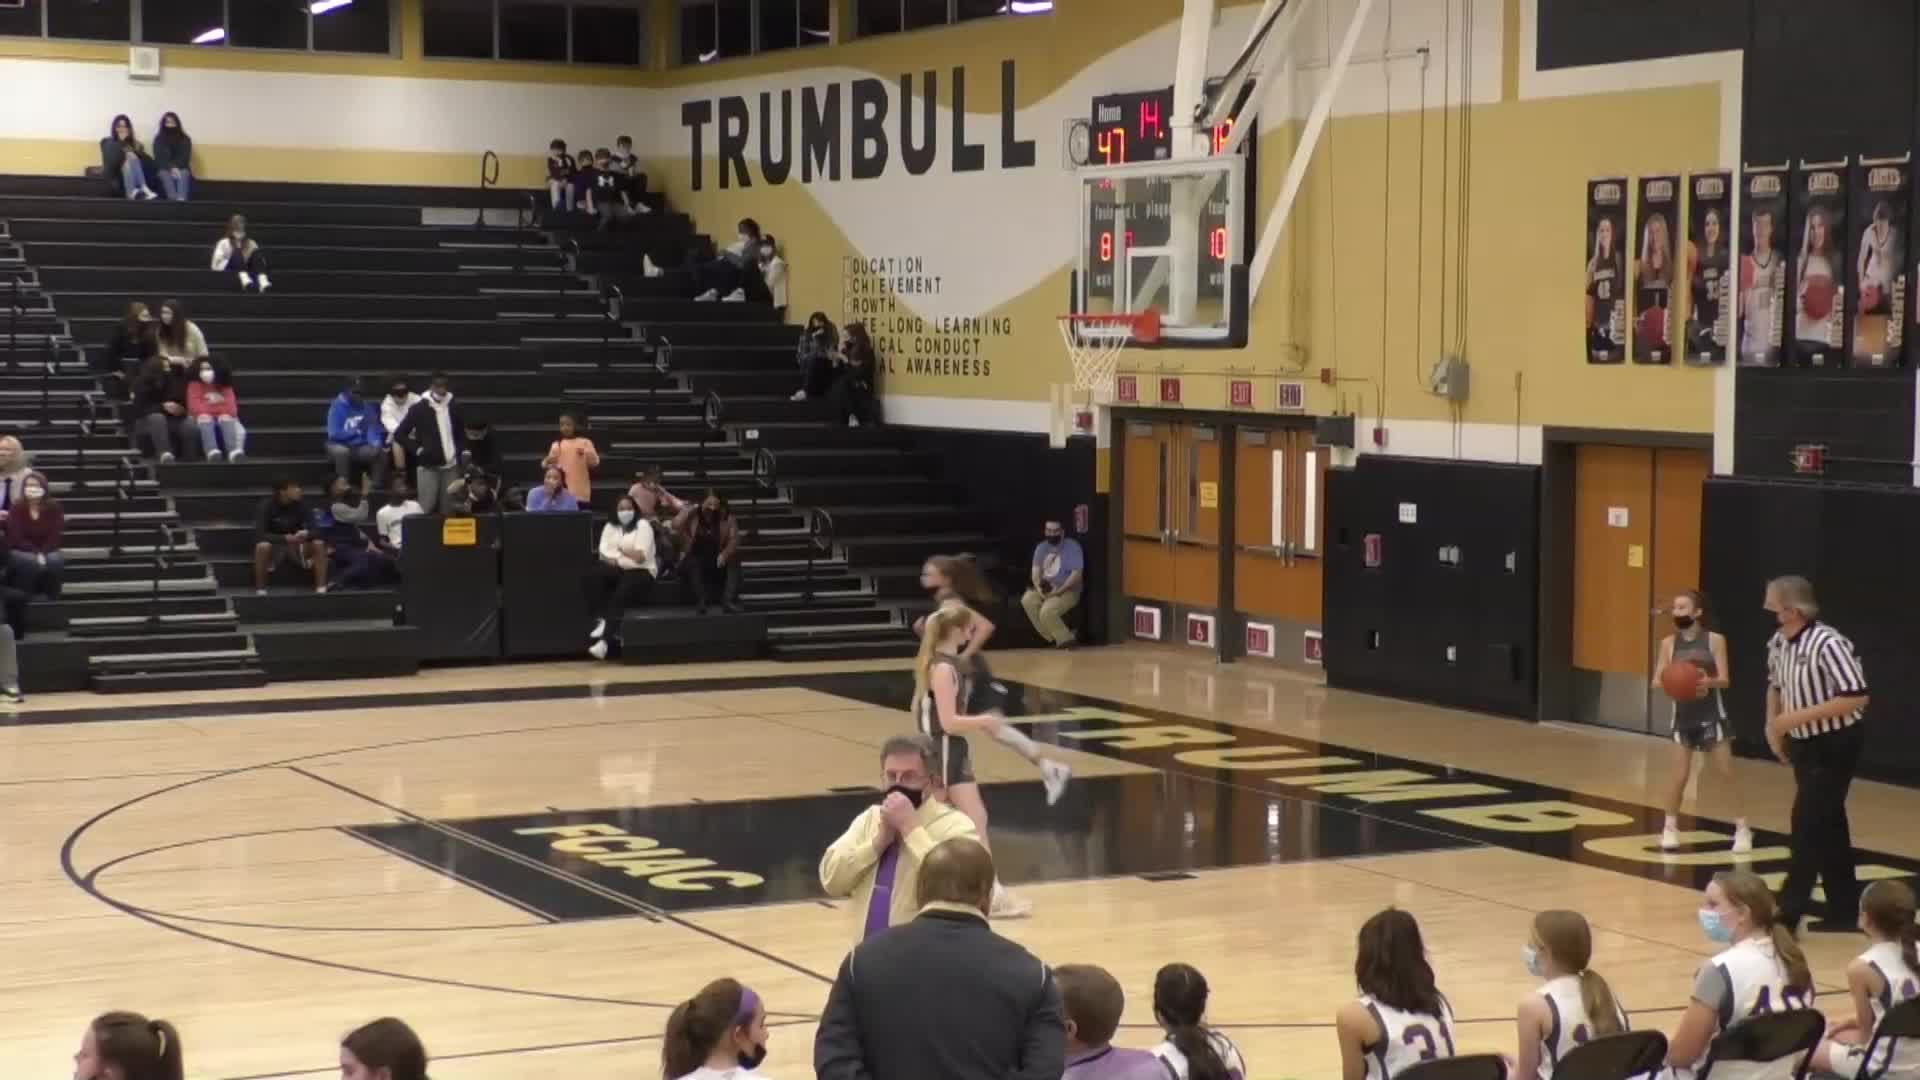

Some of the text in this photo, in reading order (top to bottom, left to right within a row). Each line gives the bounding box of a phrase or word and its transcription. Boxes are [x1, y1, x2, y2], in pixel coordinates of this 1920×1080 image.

[681, 59, 1036, 191] TRUMBULL
[1098, 127, 1125, 166] 47
[1100, 231, 1112, 261] 8
[1210, 228, 1226, 259] 10
[935, 317, 1012, 335] LEARNING
[914, 338, 981, 355] CONDUCT
[906, 358, 991, 377] AWARENESS
